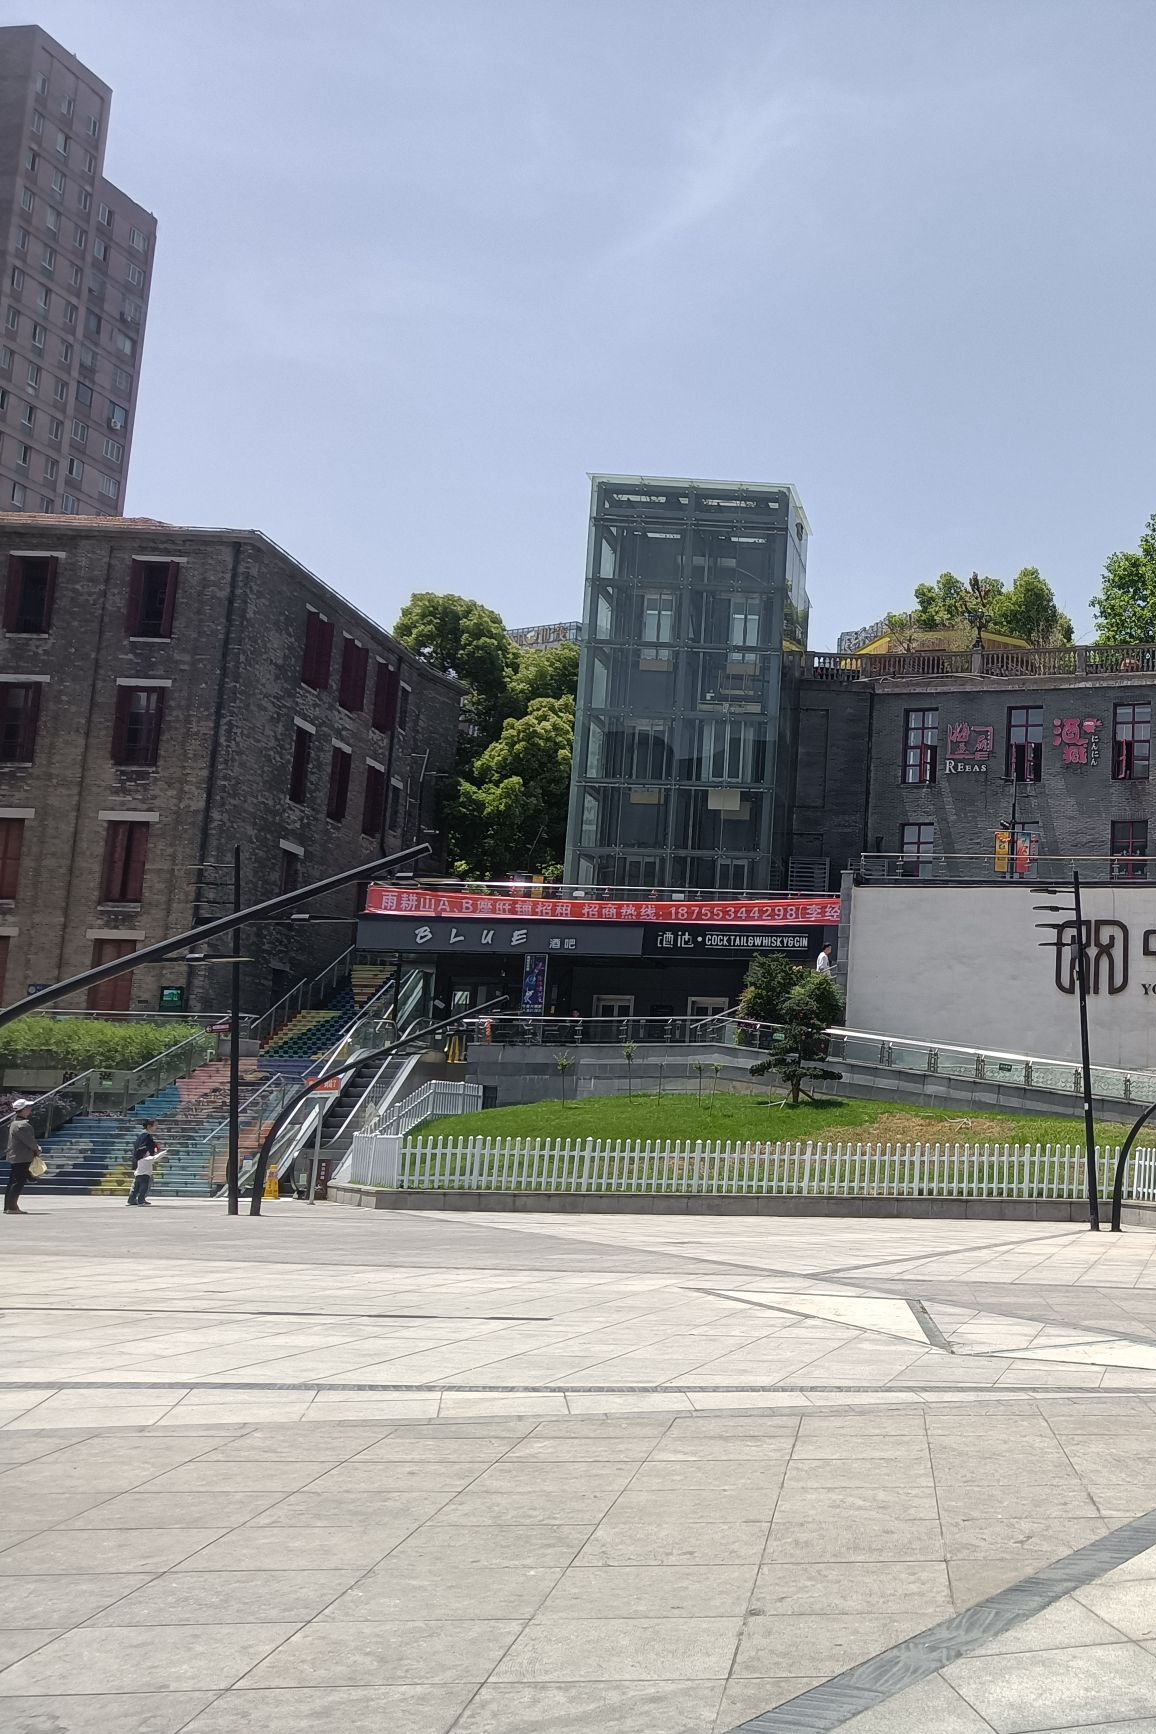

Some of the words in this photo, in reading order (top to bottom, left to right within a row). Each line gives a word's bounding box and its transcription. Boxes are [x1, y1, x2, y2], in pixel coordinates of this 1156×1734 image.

[1090, 735, 1099, 766] にんにん
[414, 925, 528, 946] BLUE
[549, 938, 576, 949] 酒吧
[705, 934, 808, 948] COCKTAIL&WHISKY&GIN
